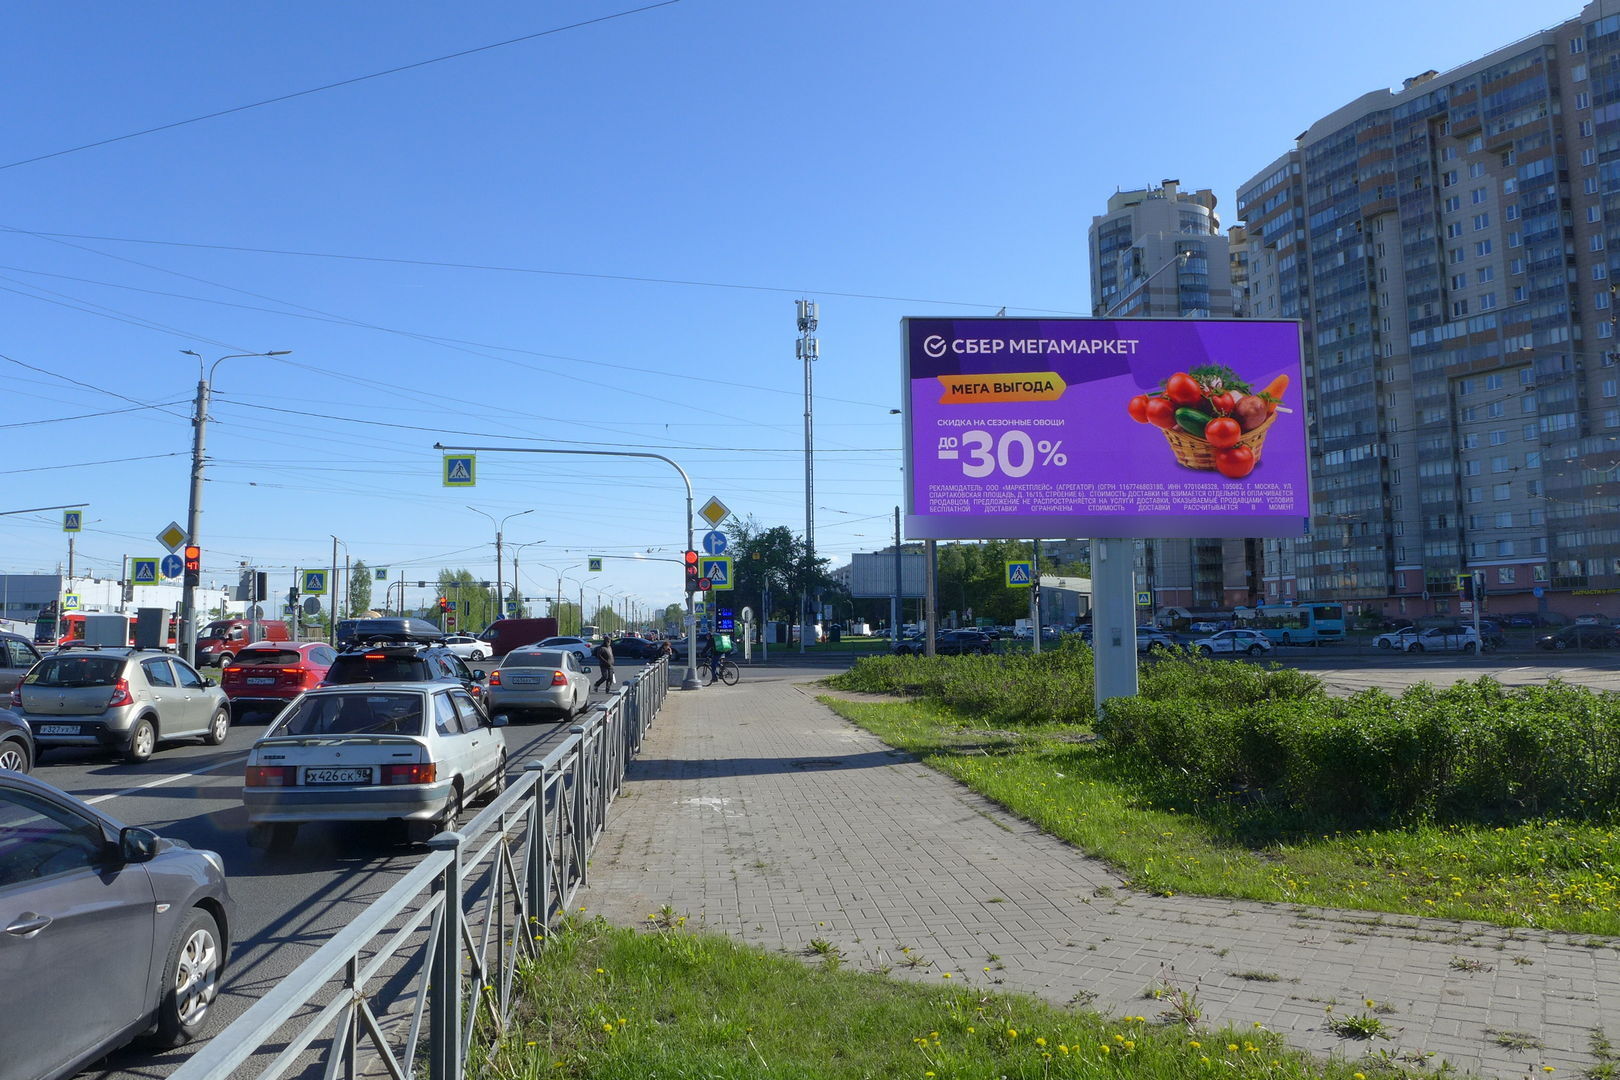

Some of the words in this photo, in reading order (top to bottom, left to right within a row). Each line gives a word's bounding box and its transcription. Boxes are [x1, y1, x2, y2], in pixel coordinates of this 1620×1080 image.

[951, 339, 1005, 354] СБЕР
[1009, 339, 1139, 354] МЕГАМАРКЕТ
[951, 383, 990, 395] МЕГА
[993, 381, 1054, 393] ВЫГОДА
[937, 419, 972, 427] СКИДКА
[1033, 419, 1065, 427] ОВОЩИ
[928, 484, 983, 492] РЕКЛАМОДАТЕЛЬ
[929, 491, 982, 499] СПАРТАКОВСКАЯ
